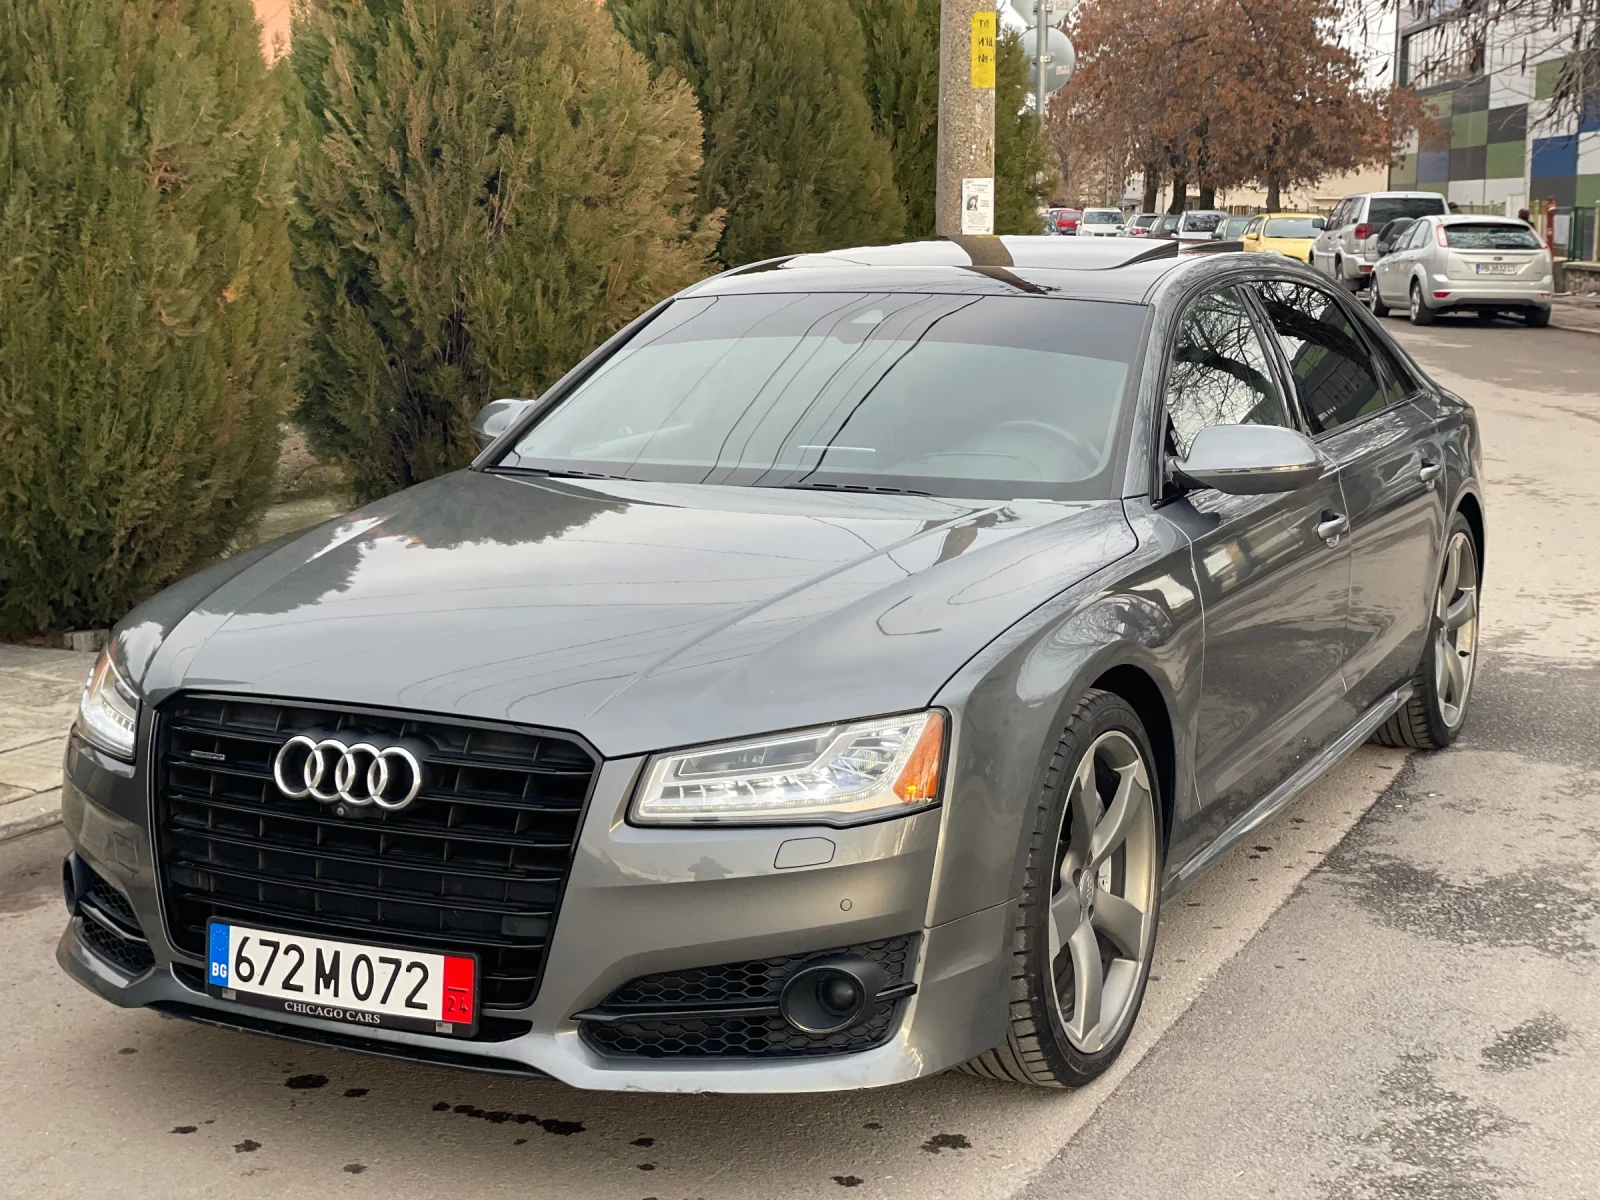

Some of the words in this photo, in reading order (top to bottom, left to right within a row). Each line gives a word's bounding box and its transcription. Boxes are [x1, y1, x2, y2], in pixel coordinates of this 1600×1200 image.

[211, 961, 228, 978] BG
[234, 936, 305, 993] 672
[314, 947, 341, 998] M
[350, 953, 430, 1011] 072
[284, 1001, 343, 1018] CHICAGO
[346, 1010, 381, 1024] CARS
[448, 995, 469, 1014] 24
